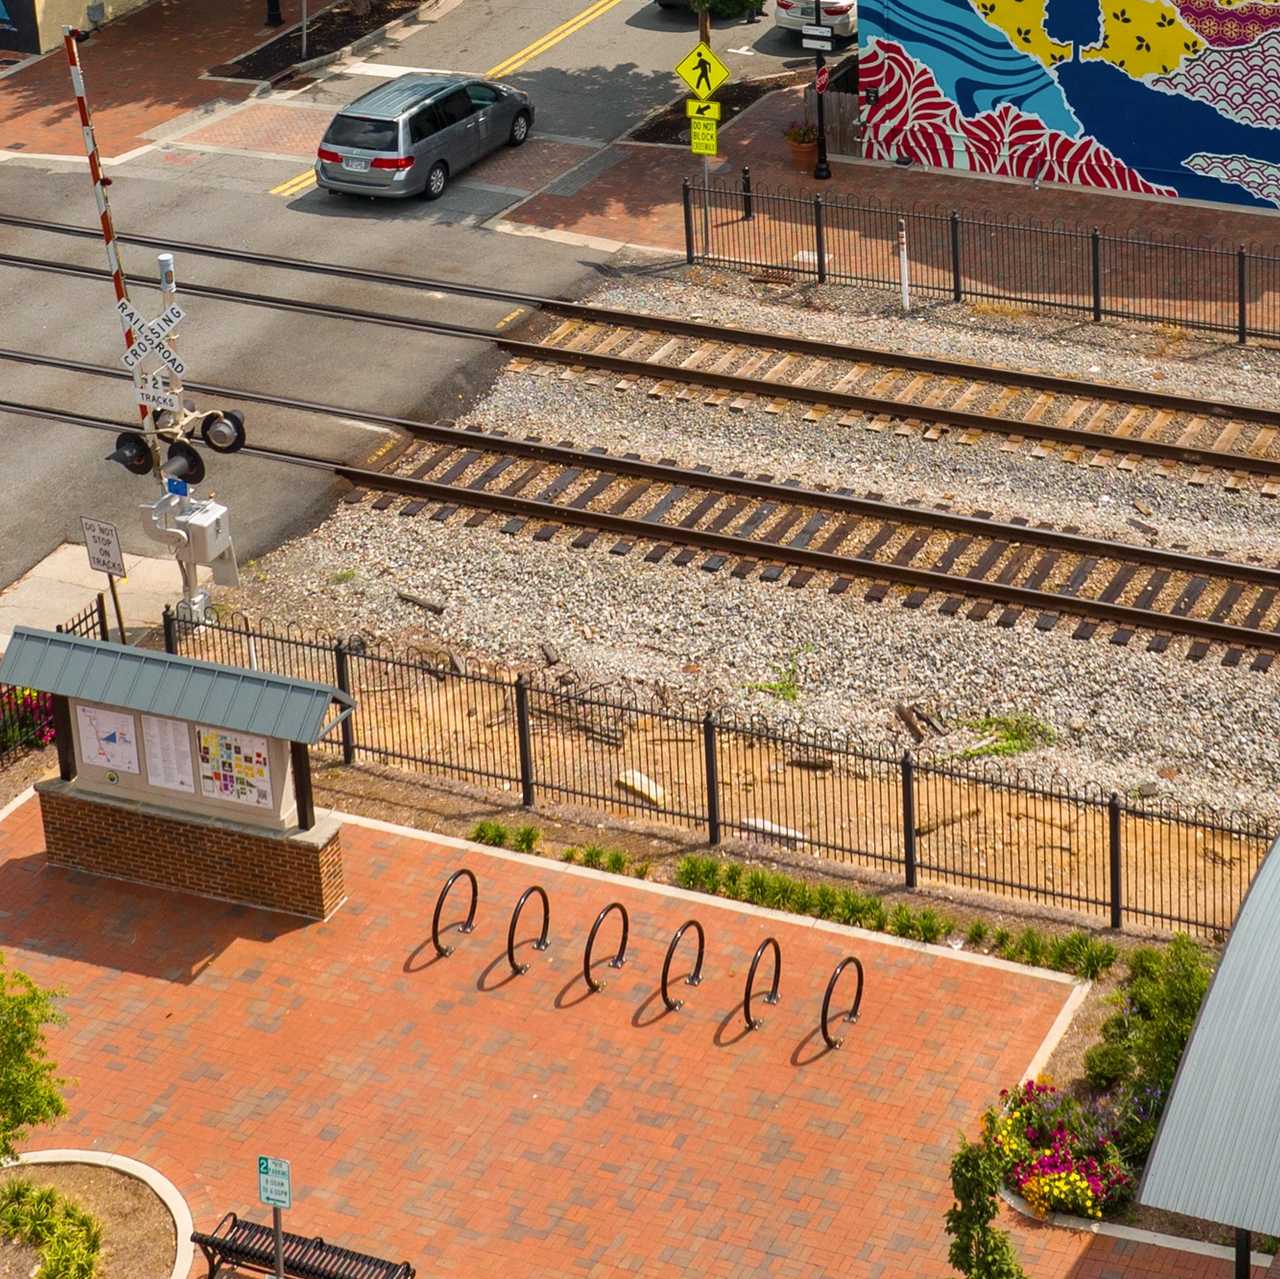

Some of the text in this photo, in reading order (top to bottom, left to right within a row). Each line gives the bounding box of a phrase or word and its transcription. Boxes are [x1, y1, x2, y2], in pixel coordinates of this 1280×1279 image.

[693, 121, 714, 131] DO NOT
[693, 131, 715, 141] BLOCK
[123, 307, 182, 367] CROSSING
[141, 393, 175, 408] TRACKS
[84, 522, 114, 537] DO NOT
[92, 535, 112, 546] STOP
[99, 547, 111, 557] ON
[92, 557, 123, 572] TRACKS
[260, 1158, 267, 1173] 2
